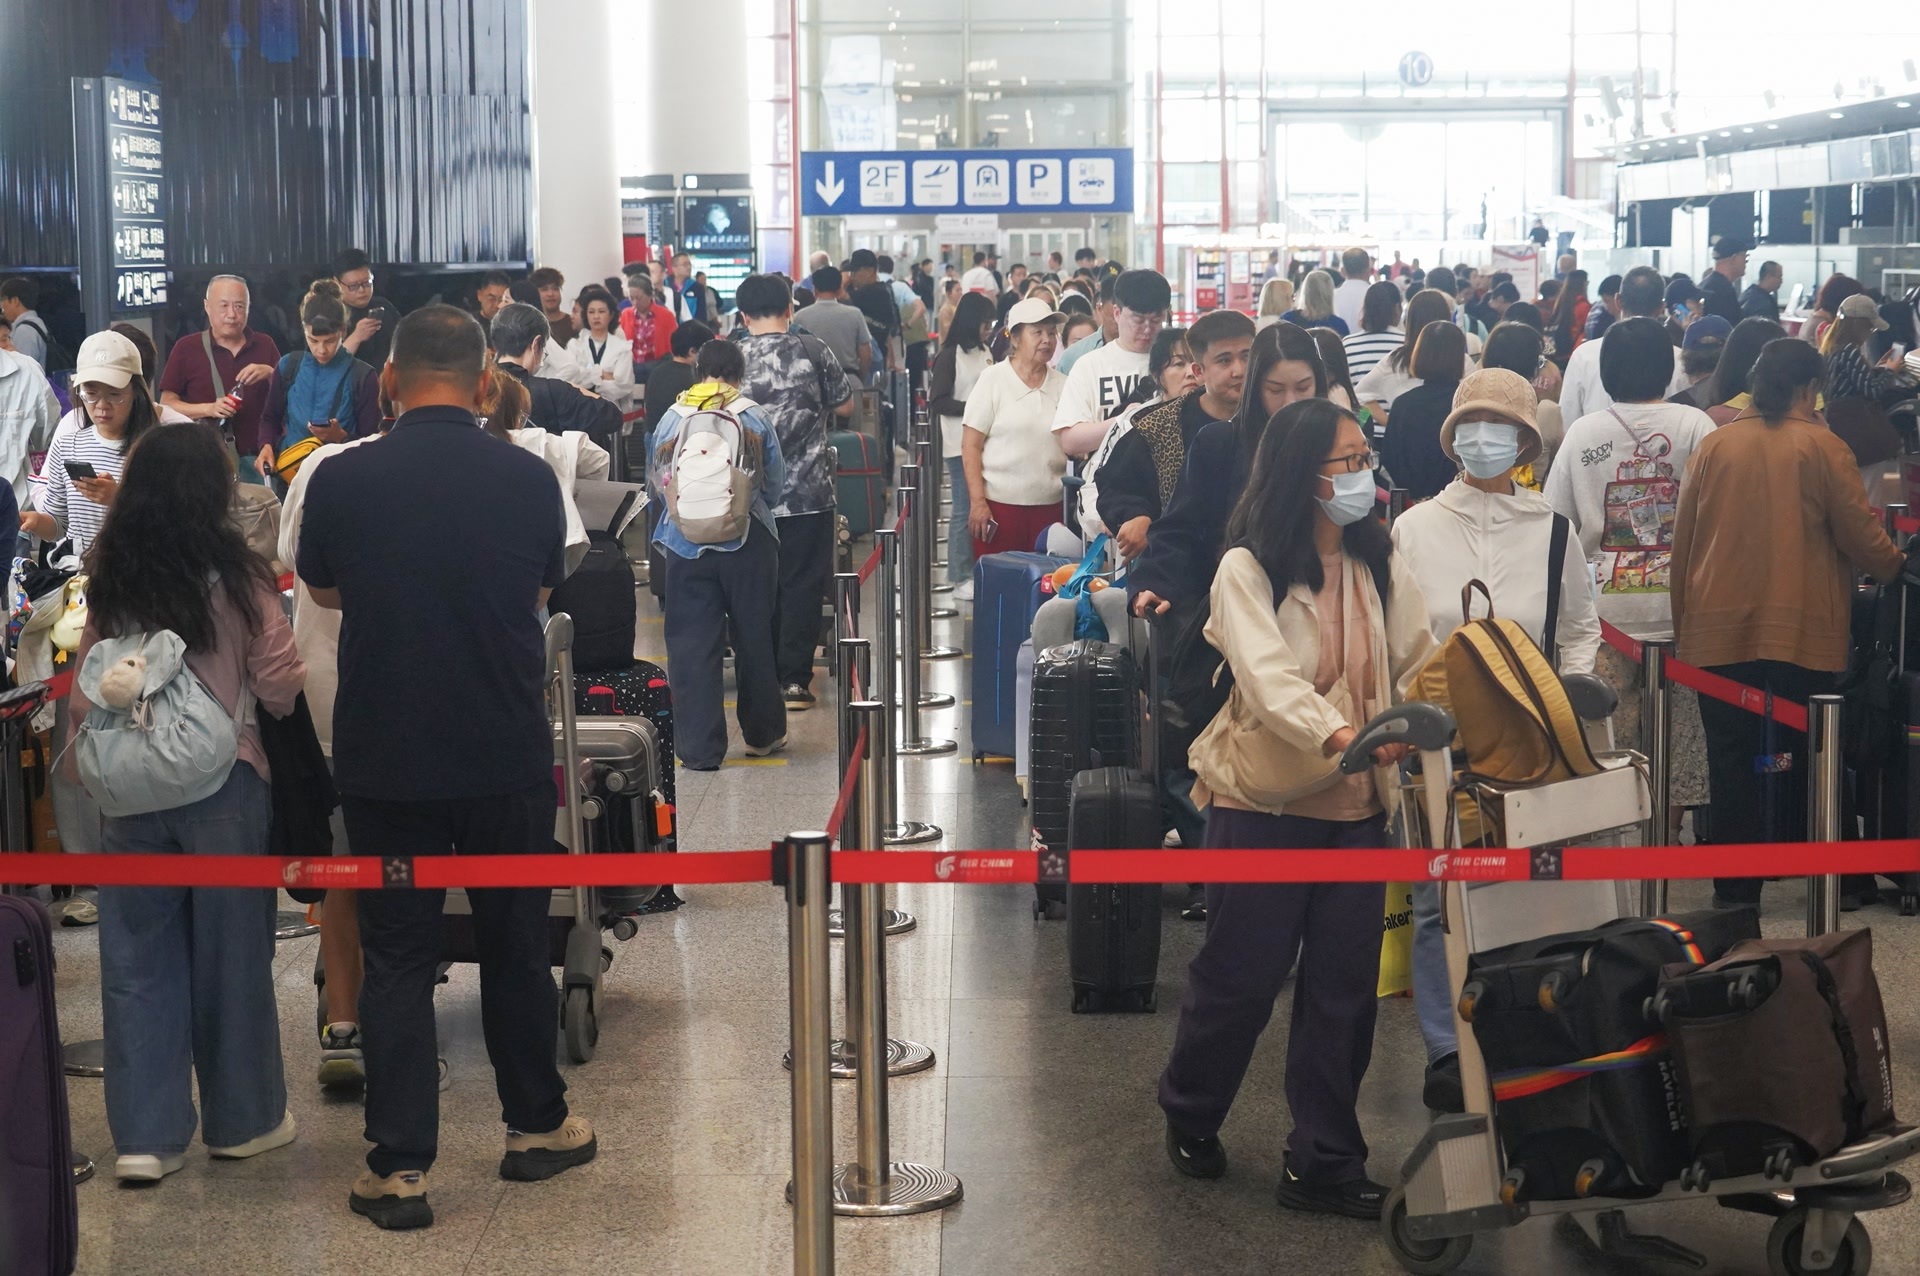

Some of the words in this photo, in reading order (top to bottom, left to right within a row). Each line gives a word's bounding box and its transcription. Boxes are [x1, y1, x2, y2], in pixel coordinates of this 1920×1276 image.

[1400, 54, 1431, 83] 10
[866, 166, 899, 187] 2F
[1030, 164, 1048, 188] P
[1581, 440, 1613, 467] SNOOPY
[1593, 451, 1611, 465] SHOW
[305, 863, 325, 874] AIR
[326, 864, 359, 874] CHINA
[959, 858, 978, 868] AIR
[980, 858, 1014, 868] CHINA
[1452, 856, 1471, 867] AIR
[1473, 856, 1506, 866] CHINA
[1383, 909, 1413, 932] aker
